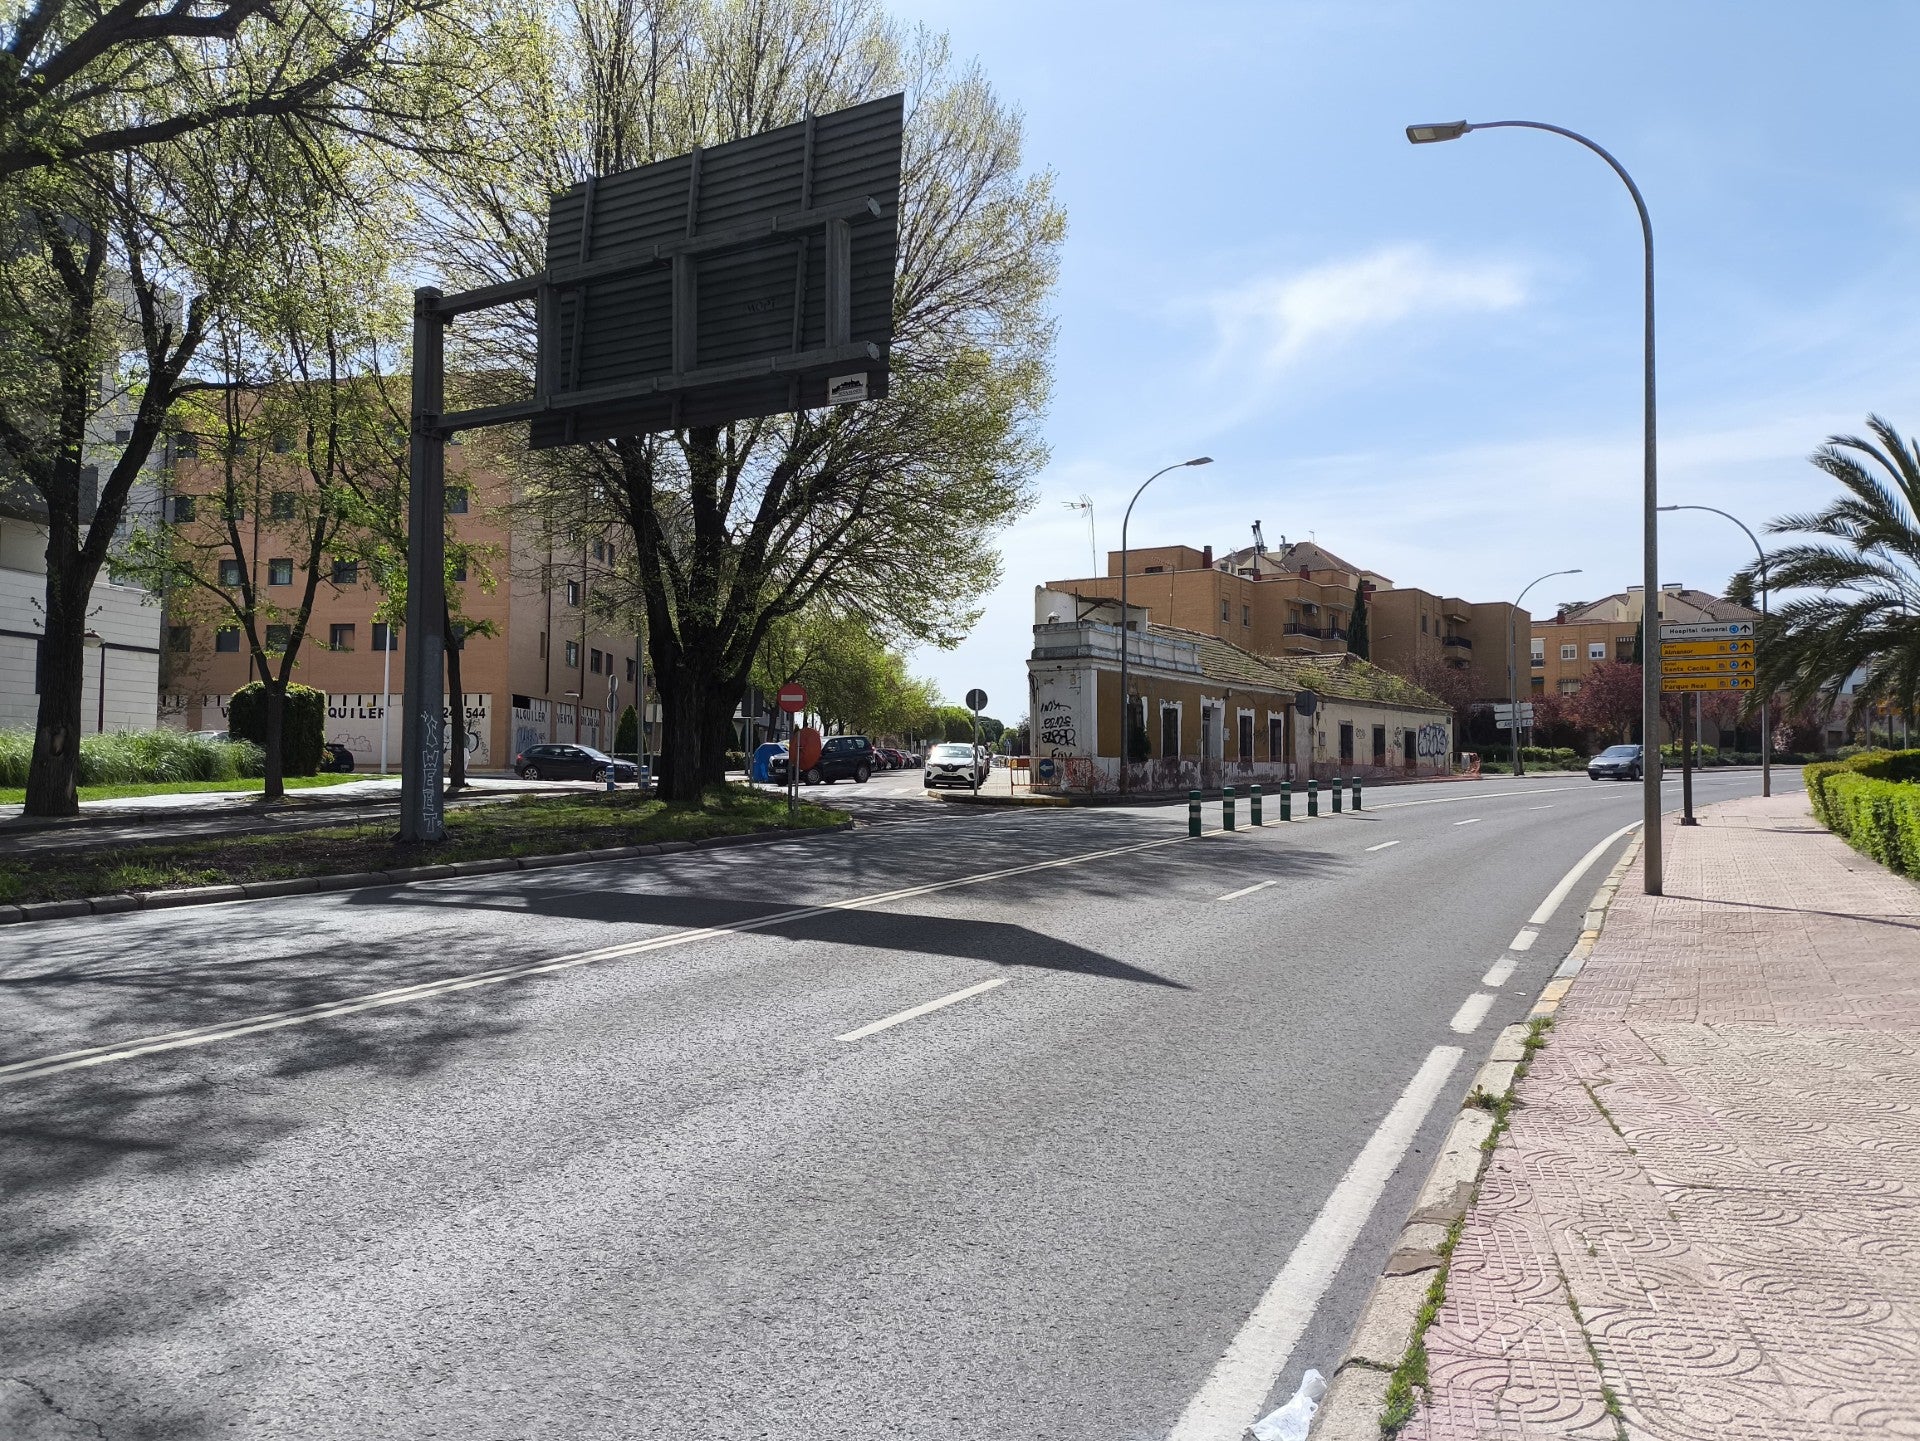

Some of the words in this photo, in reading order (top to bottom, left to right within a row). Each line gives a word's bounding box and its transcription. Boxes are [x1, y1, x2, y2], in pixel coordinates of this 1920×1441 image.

[328, 707, 384, 719] QUILER
[465, 707, 486, 719] 544
[557, 713, 574, 725] VENTA
